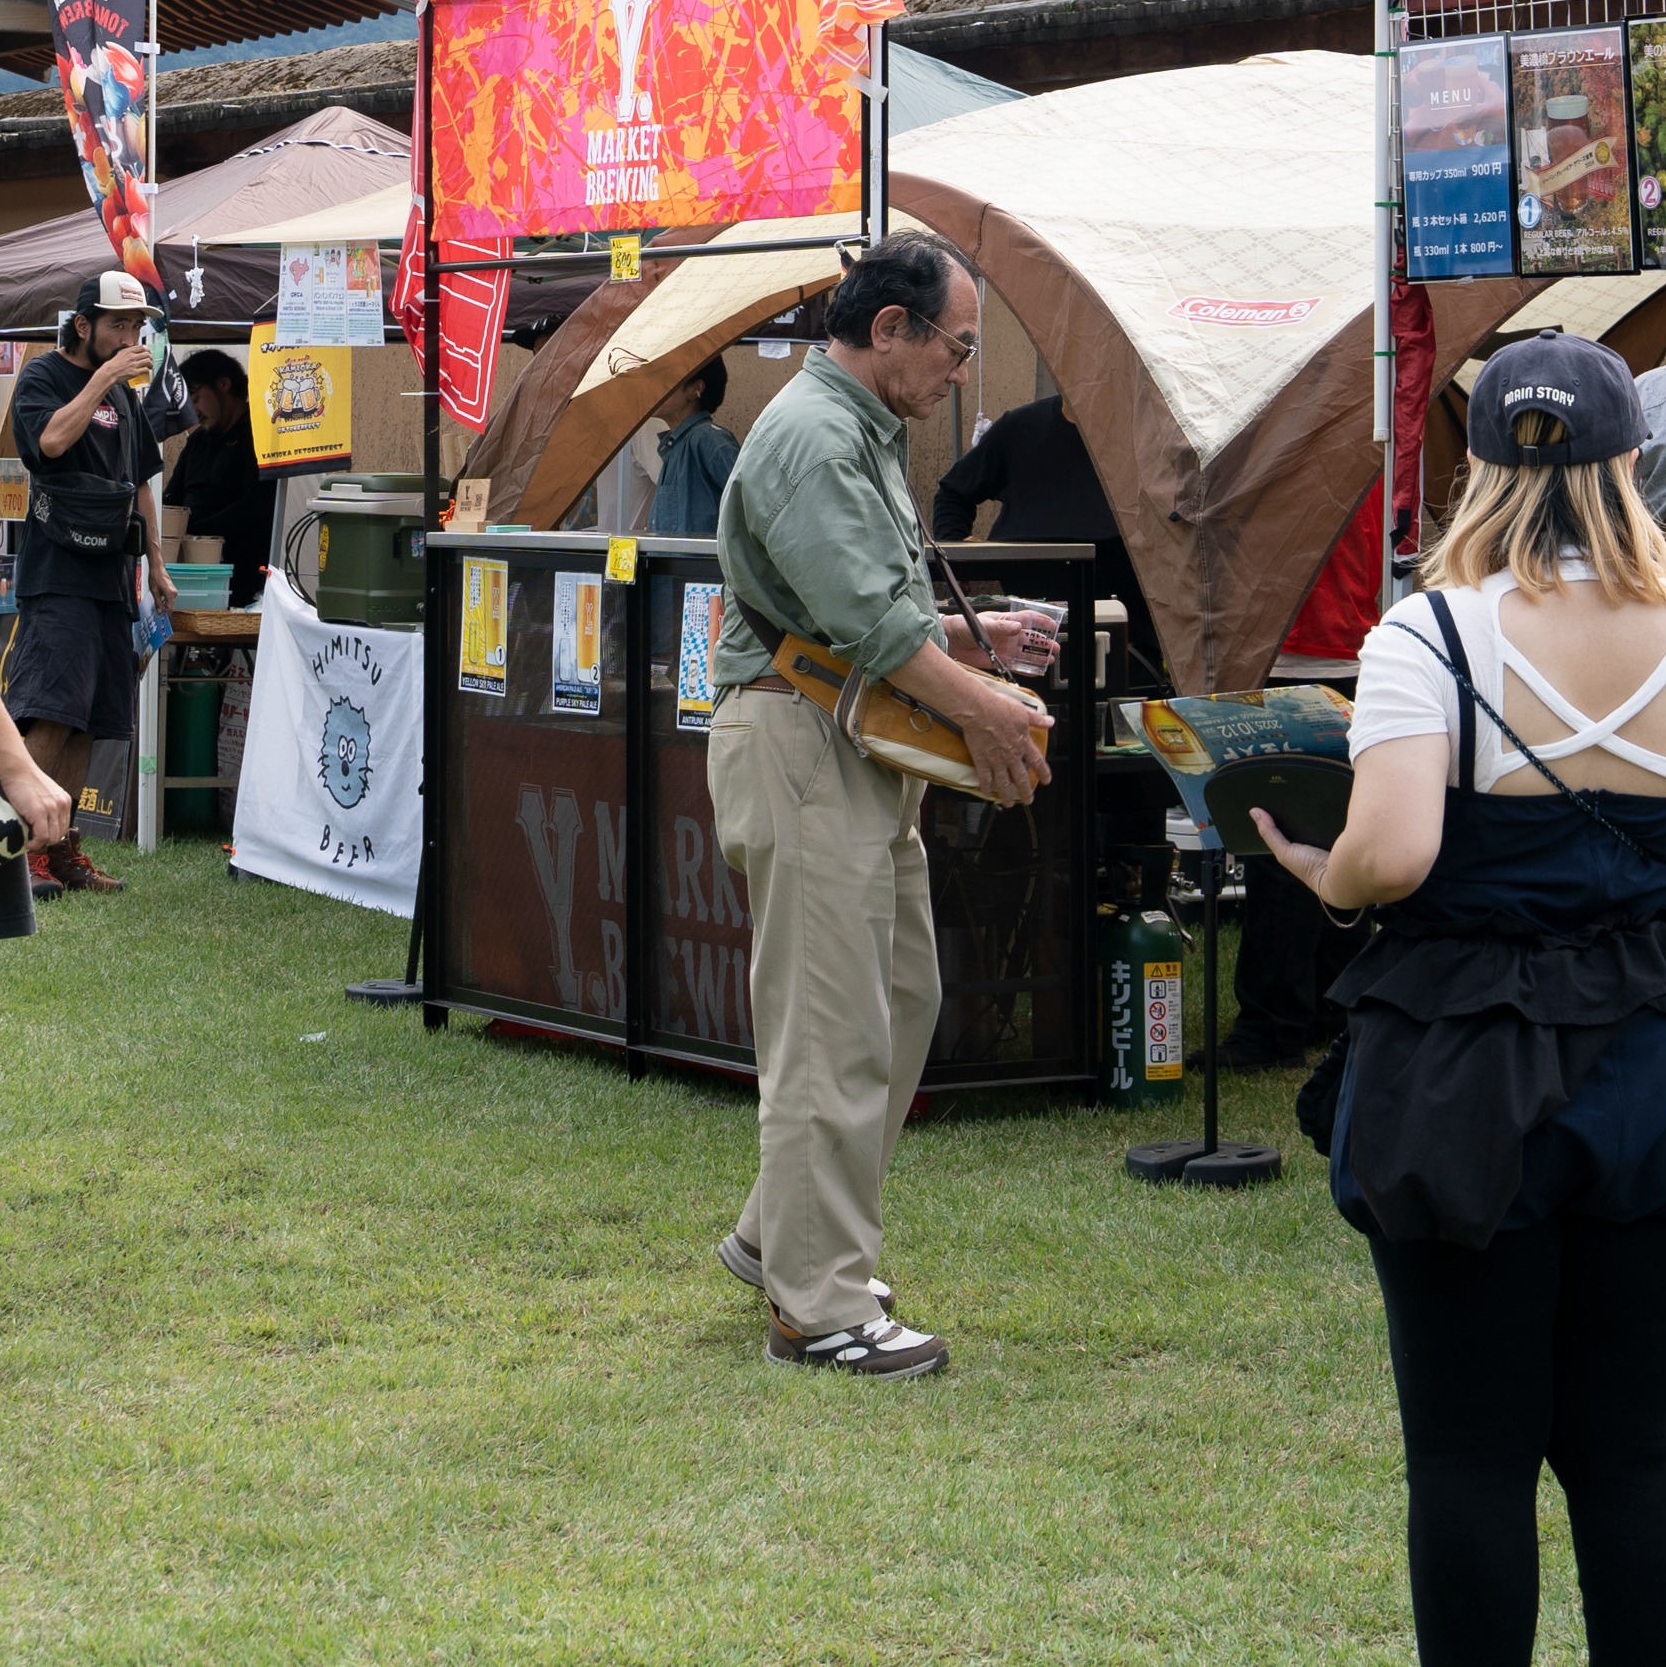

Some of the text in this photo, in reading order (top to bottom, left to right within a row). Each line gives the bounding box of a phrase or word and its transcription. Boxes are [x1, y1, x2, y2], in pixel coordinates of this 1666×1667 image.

[1519, 45, 1616, 69] 美濃橋ブラウンエール
[1430, 88, 1471, 105] MENU
[586, 124, 662, 164] MARKET
[1443, 167, 1467, 179] 350ml
[585, 166, 659, 207] BREWING
[1643, 179, 1657, 205] 2
[1473, 210, 1507, 224] 2,620円
[1522, 197, 1534, 224] 1
[1523, 228, 1554, 240] REGULAR
[1424, 243, 1450, 256] 330ml
[1504, 386, 1575, 407] MAIN STORY
[262, 450, 291, 460] KAMIOKA
[312, 635, 382, 685] HIMITSU
[319, 824, 374, 868] BEER
[1110, 960, 1133, 1091] キリンビール
